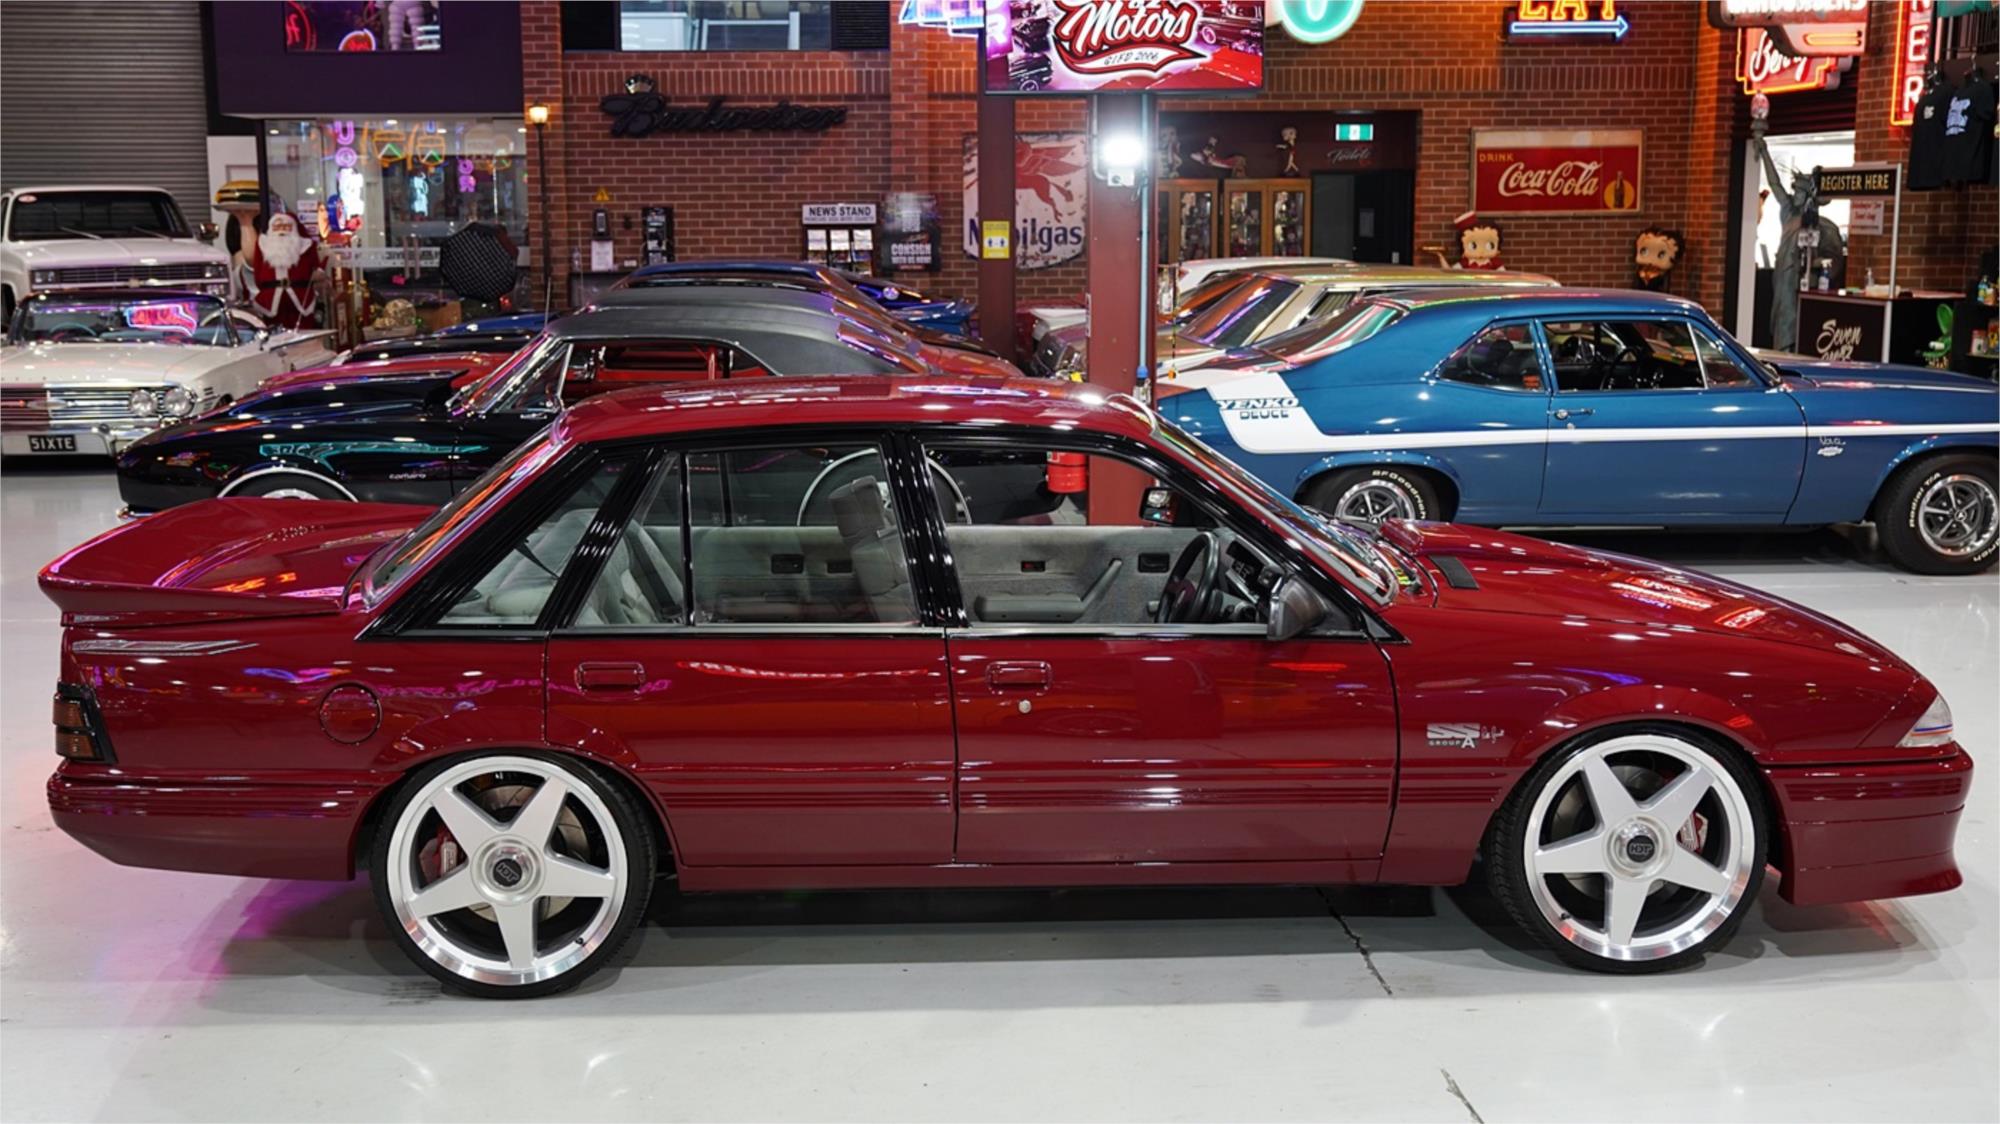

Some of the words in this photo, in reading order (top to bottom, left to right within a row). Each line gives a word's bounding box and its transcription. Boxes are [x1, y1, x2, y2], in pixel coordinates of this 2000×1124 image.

[1061, 1, 1191, 54] Motors
[1479, 152, 1514, 163] DRINK
[1498, 160, 1604, 198] Coca-Cola
[1820, 175, 1862, 191] REGISTER
[1864, 173, 1890, 190] HERE
[809, 206, 837, 217] NEWS
[839, 206, 872, 217] STAND
[891, 243, 932, 256] CONSIGN
[1816, 319, 1862, 354] Seven
[1216, 397, 1300, 410] YENKO
[1240, 409, 1289, 420] DEUCE
[1461, 736, 1475, 749] A
